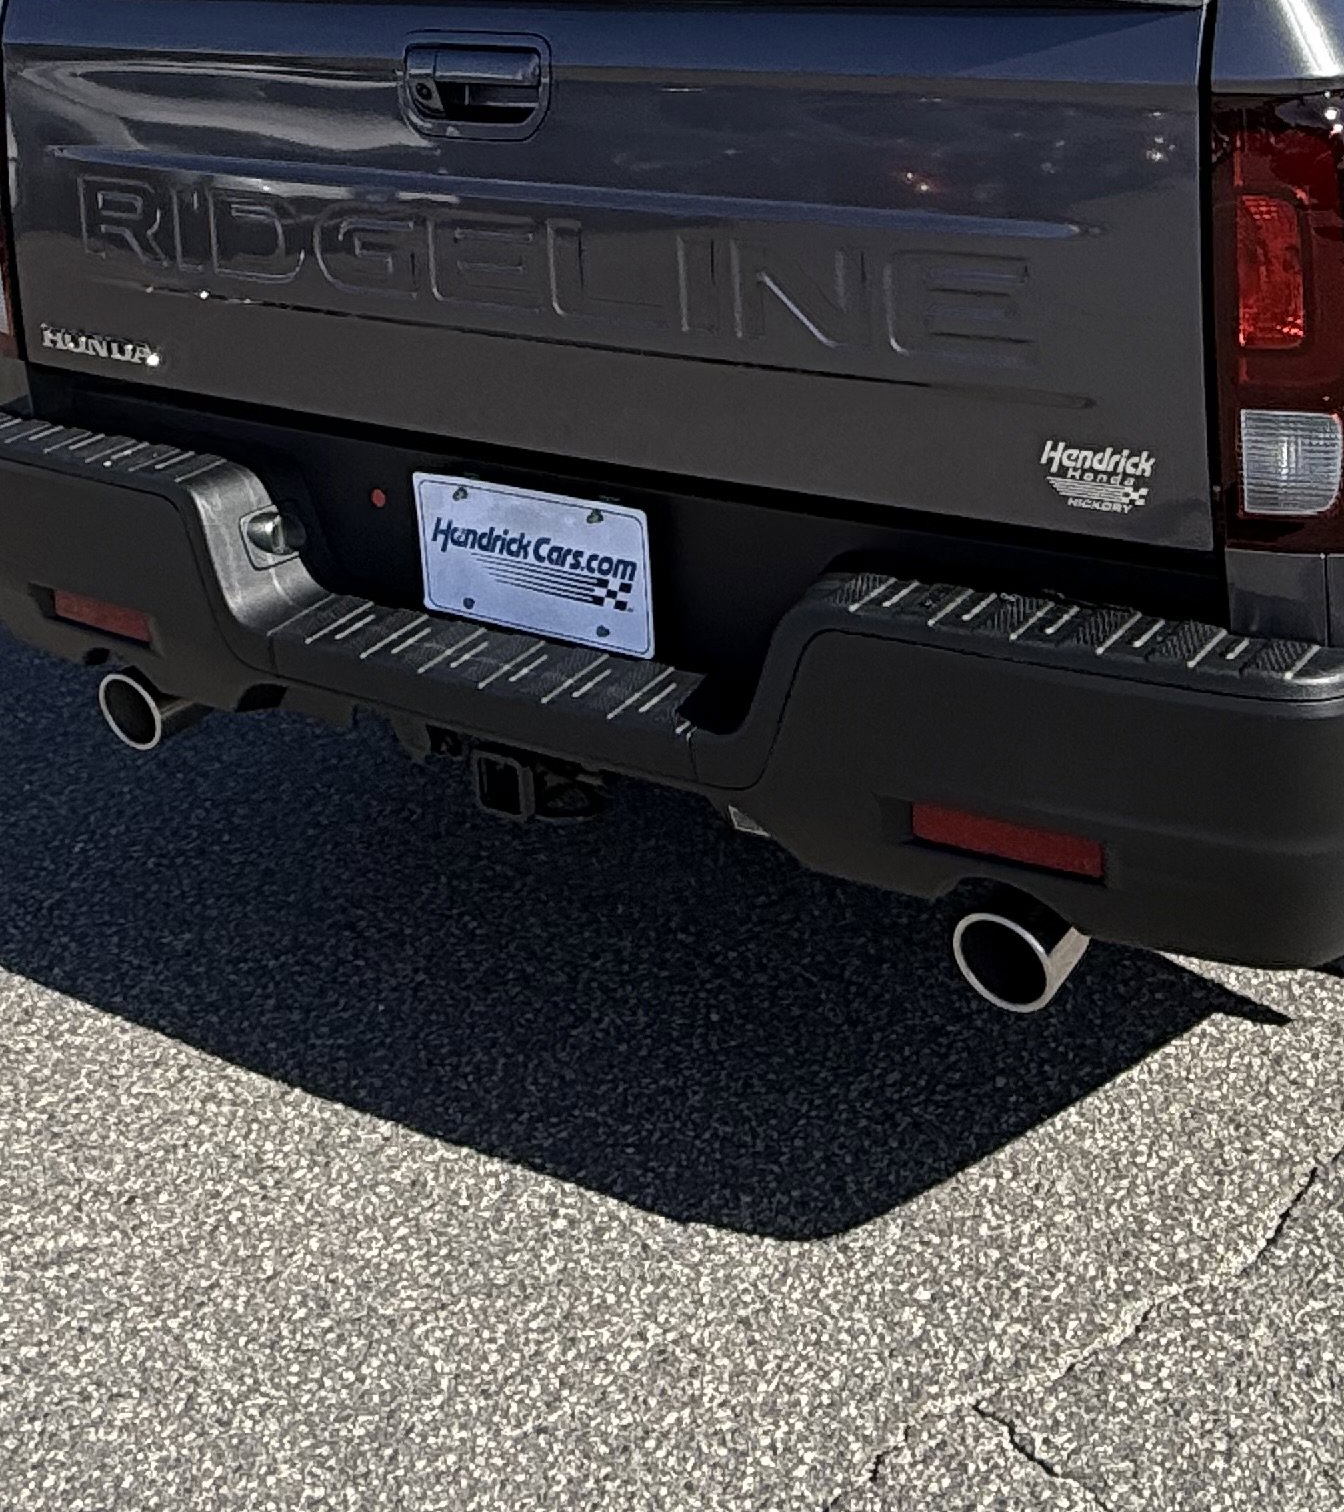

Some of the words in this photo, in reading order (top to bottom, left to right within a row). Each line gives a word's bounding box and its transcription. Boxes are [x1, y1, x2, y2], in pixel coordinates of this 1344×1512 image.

[79, 175, 1035, 369] RIDGELINE
[1040, 440, 1156, 477] Hendrick
[1066, 468, 1135, 486] Honda
[1067, 497, 1133, 513] HICKORY
